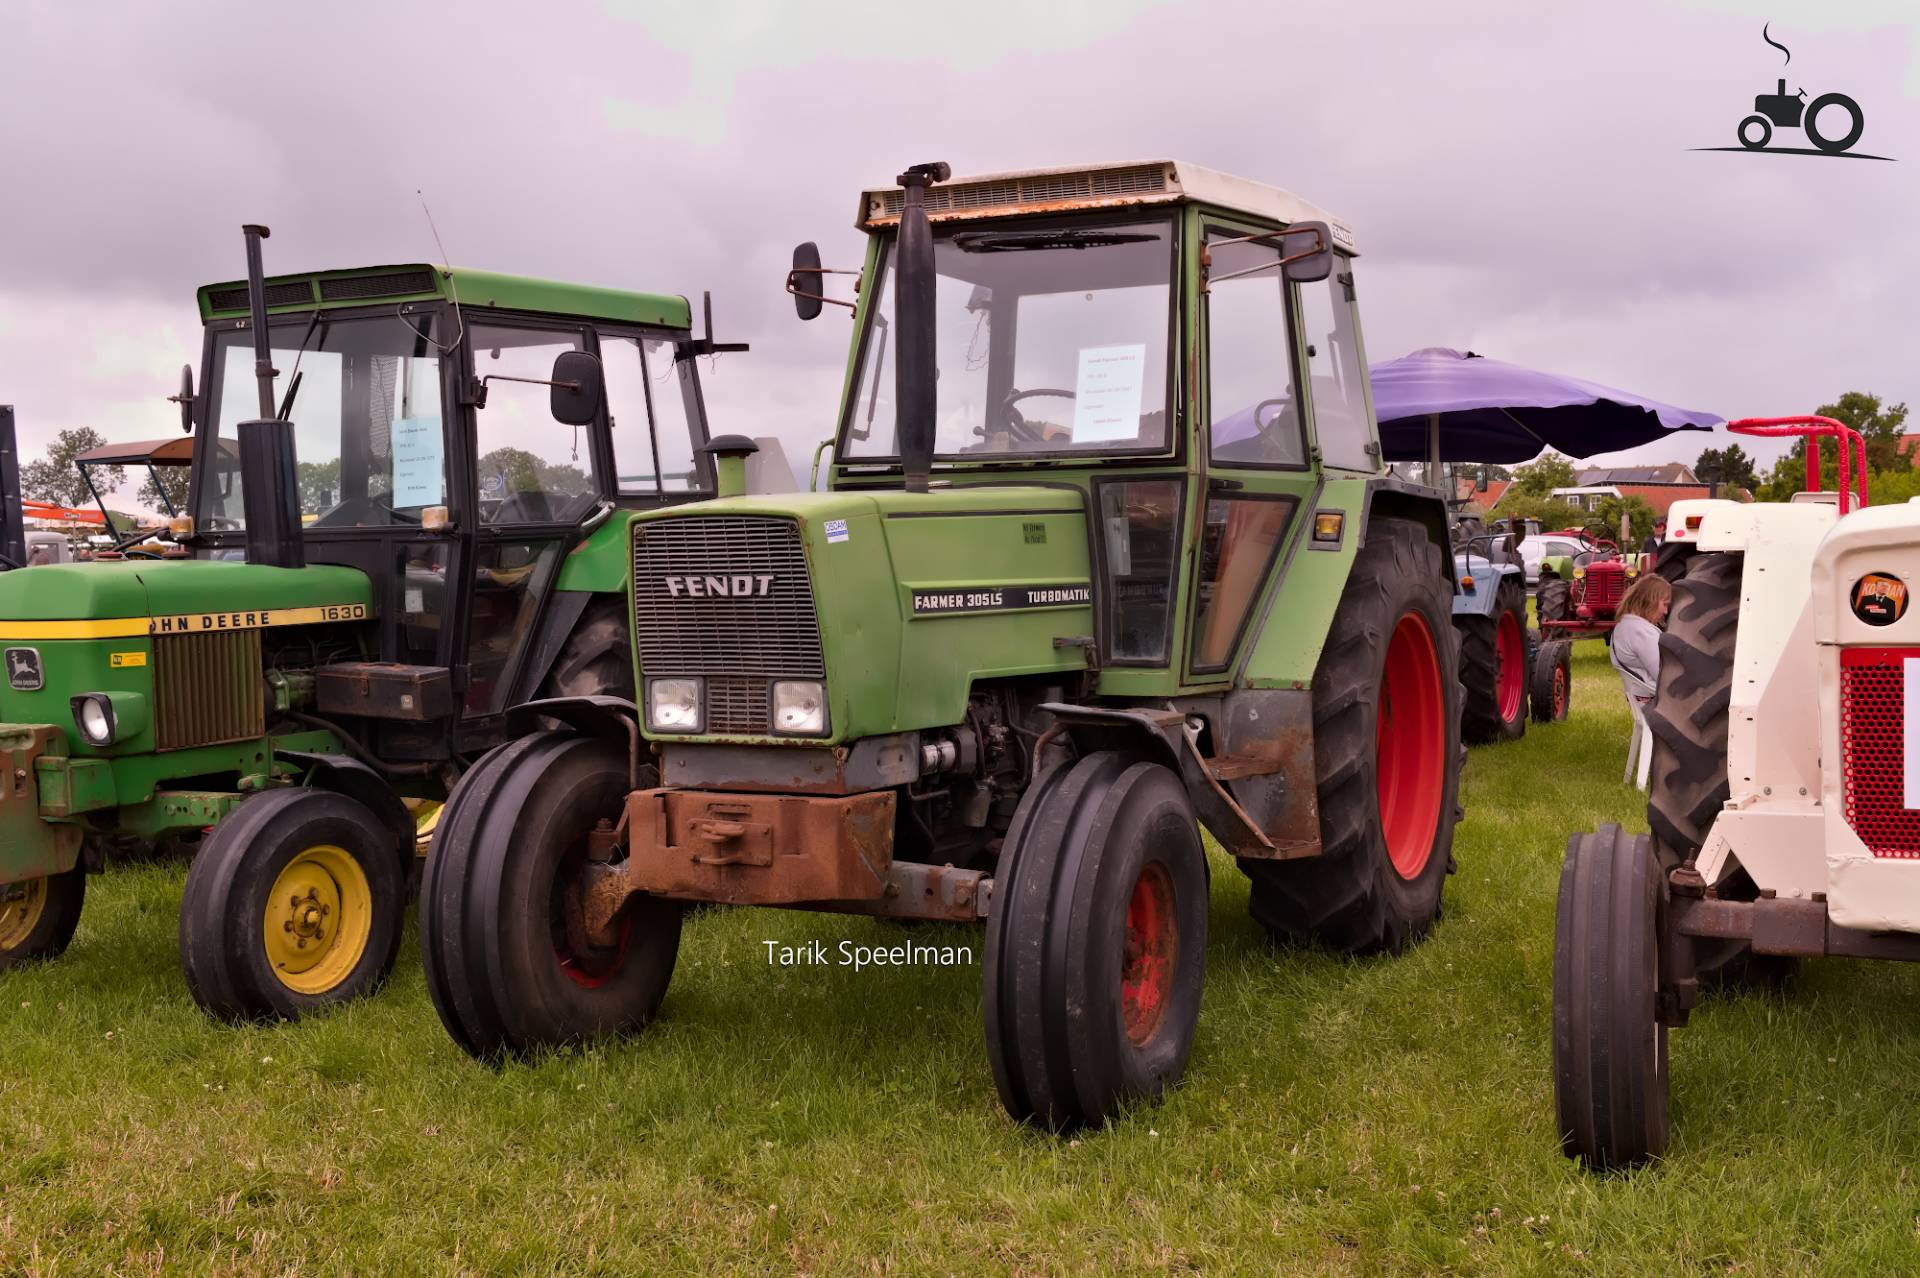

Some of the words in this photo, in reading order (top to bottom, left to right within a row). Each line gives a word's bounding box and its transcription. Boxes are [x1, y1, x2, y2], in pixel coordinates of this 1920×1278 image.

[665, 575, 775, 597] FENDT
[915, 594, 964, 610] FARMER
[967, 592, 1003, 607] 305LS
[1027, 588, 1090, 604] TURBOMATIK
[202, 612, 270, 629] DEERE
[319, 605, 364, 621] 1630
